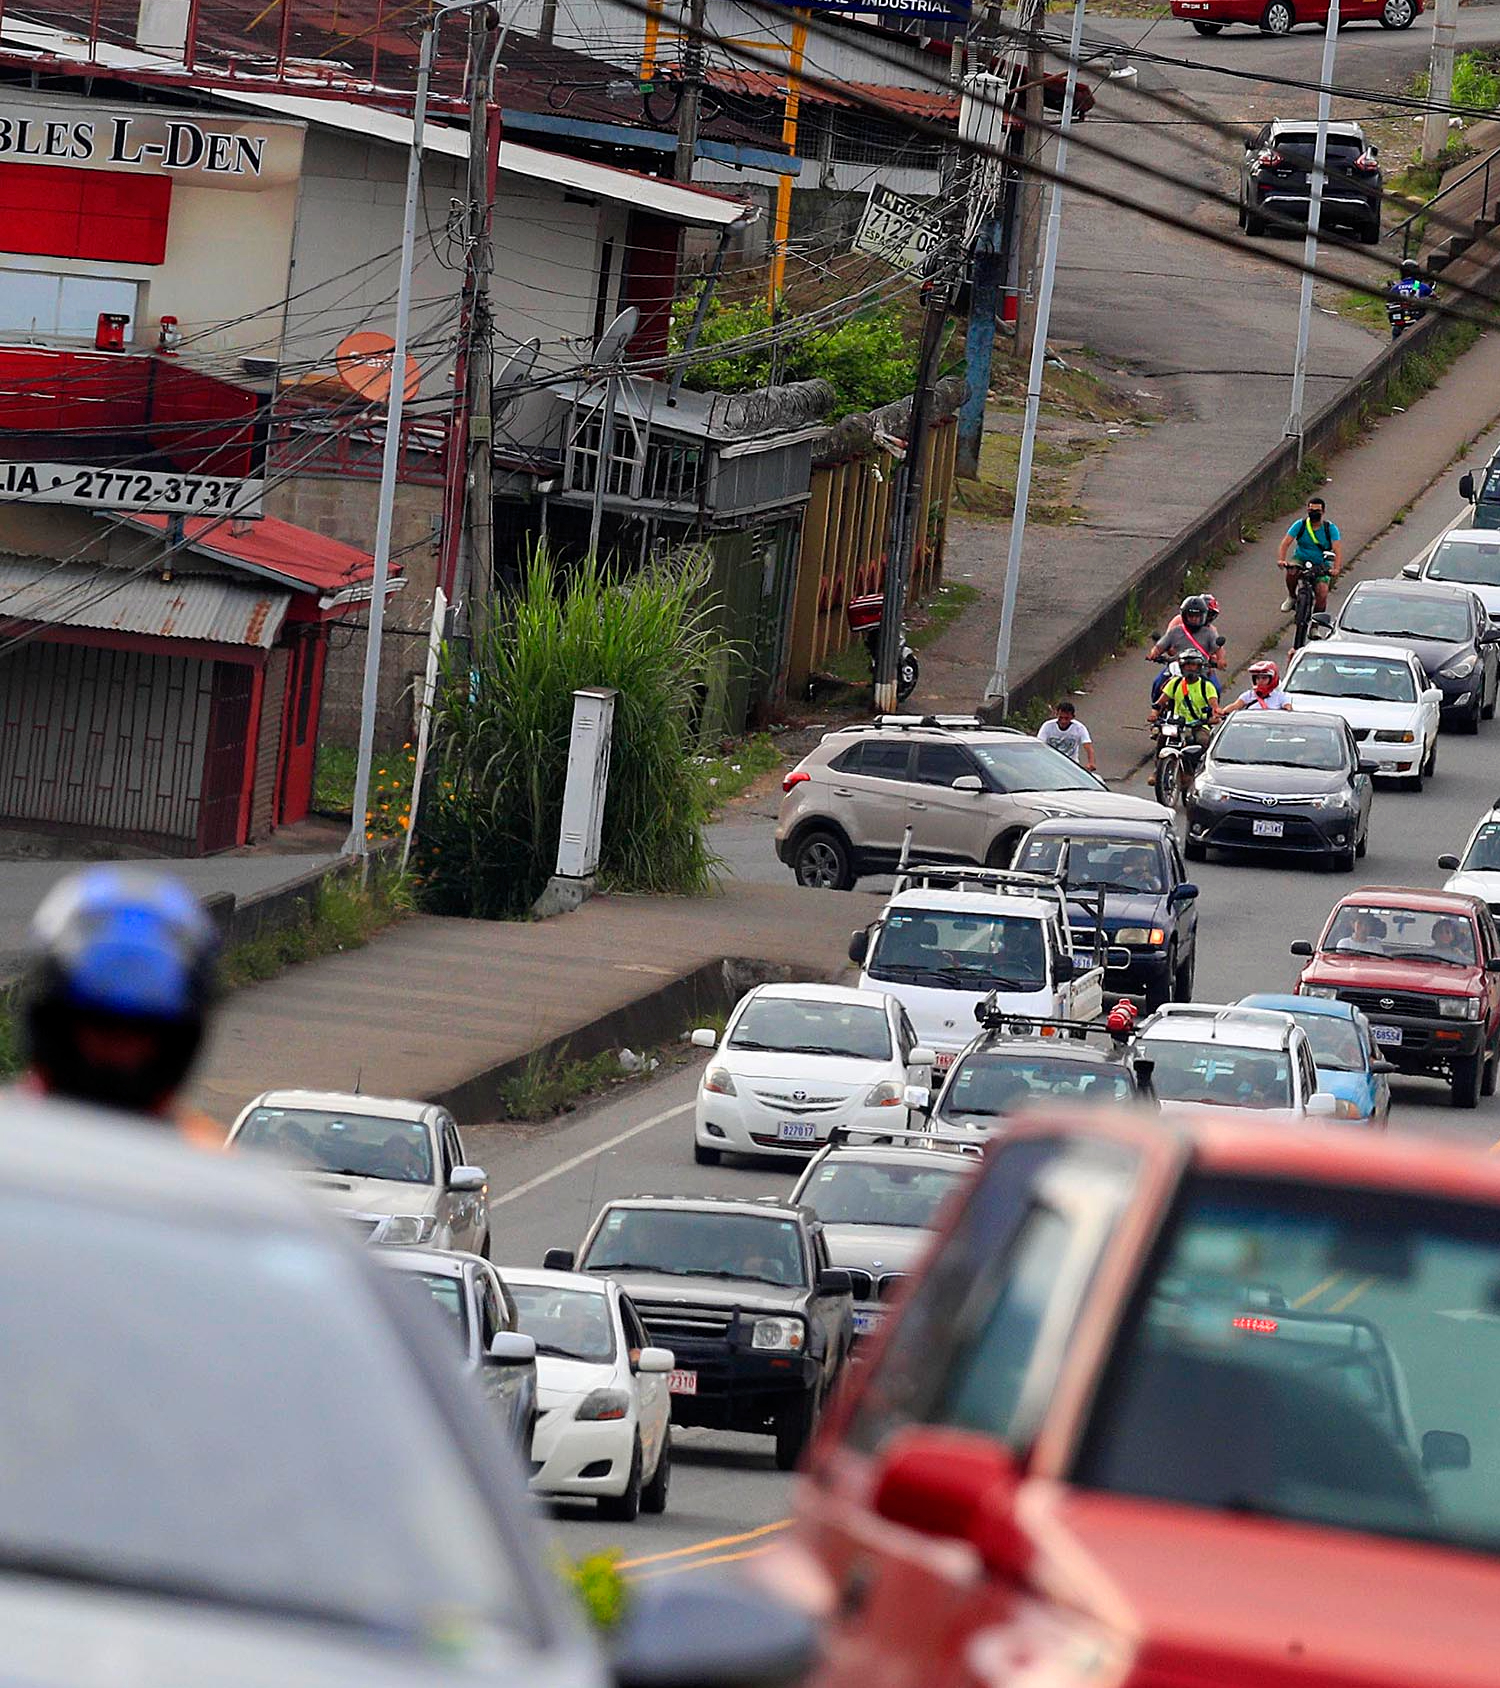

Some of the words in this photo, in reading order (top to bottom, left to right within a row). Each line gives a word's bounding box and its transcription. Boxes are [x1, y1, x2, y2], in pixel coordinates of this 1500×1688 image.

[861, 0, 951, 13] INDUSTRIAL
[108, 117, 267, 176] L-DEN
[0, 465, 39, 494] IA
[73, 470, 243, 509] 2772-3737
